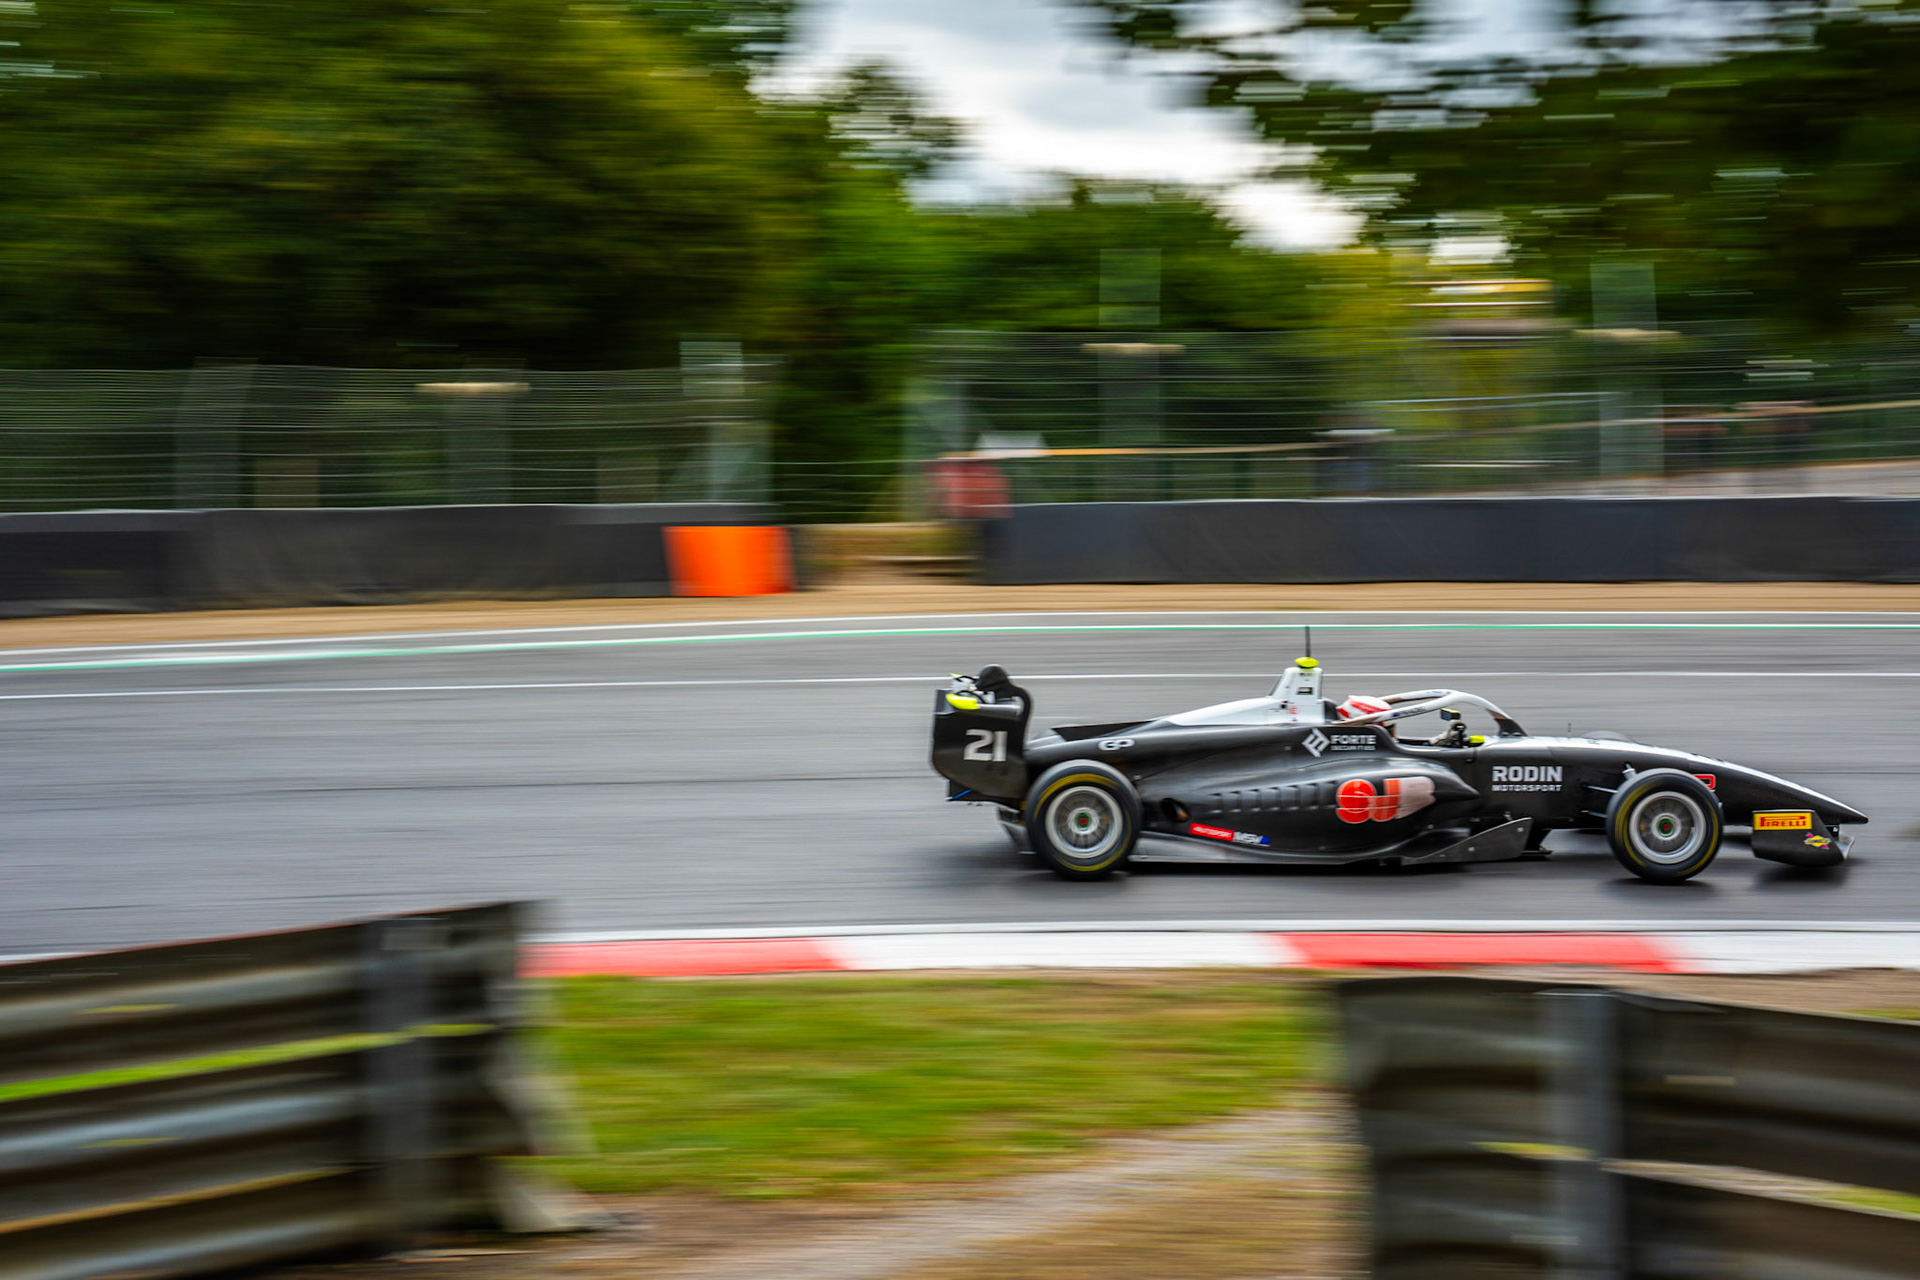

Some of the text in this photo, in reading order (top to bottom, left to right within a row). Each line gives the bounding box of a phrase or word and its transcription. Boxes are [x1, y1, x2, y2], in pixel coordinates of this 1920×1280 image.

[963, 729, 1008, 762] 21
[1330, 734, 1377, 745] FORTE
[1492, 765, 1563, 782] RODIN
[1491, 784, 1563, 792] MOTORSPORT
[1760, 815, 1806, 827] PIRELLI
